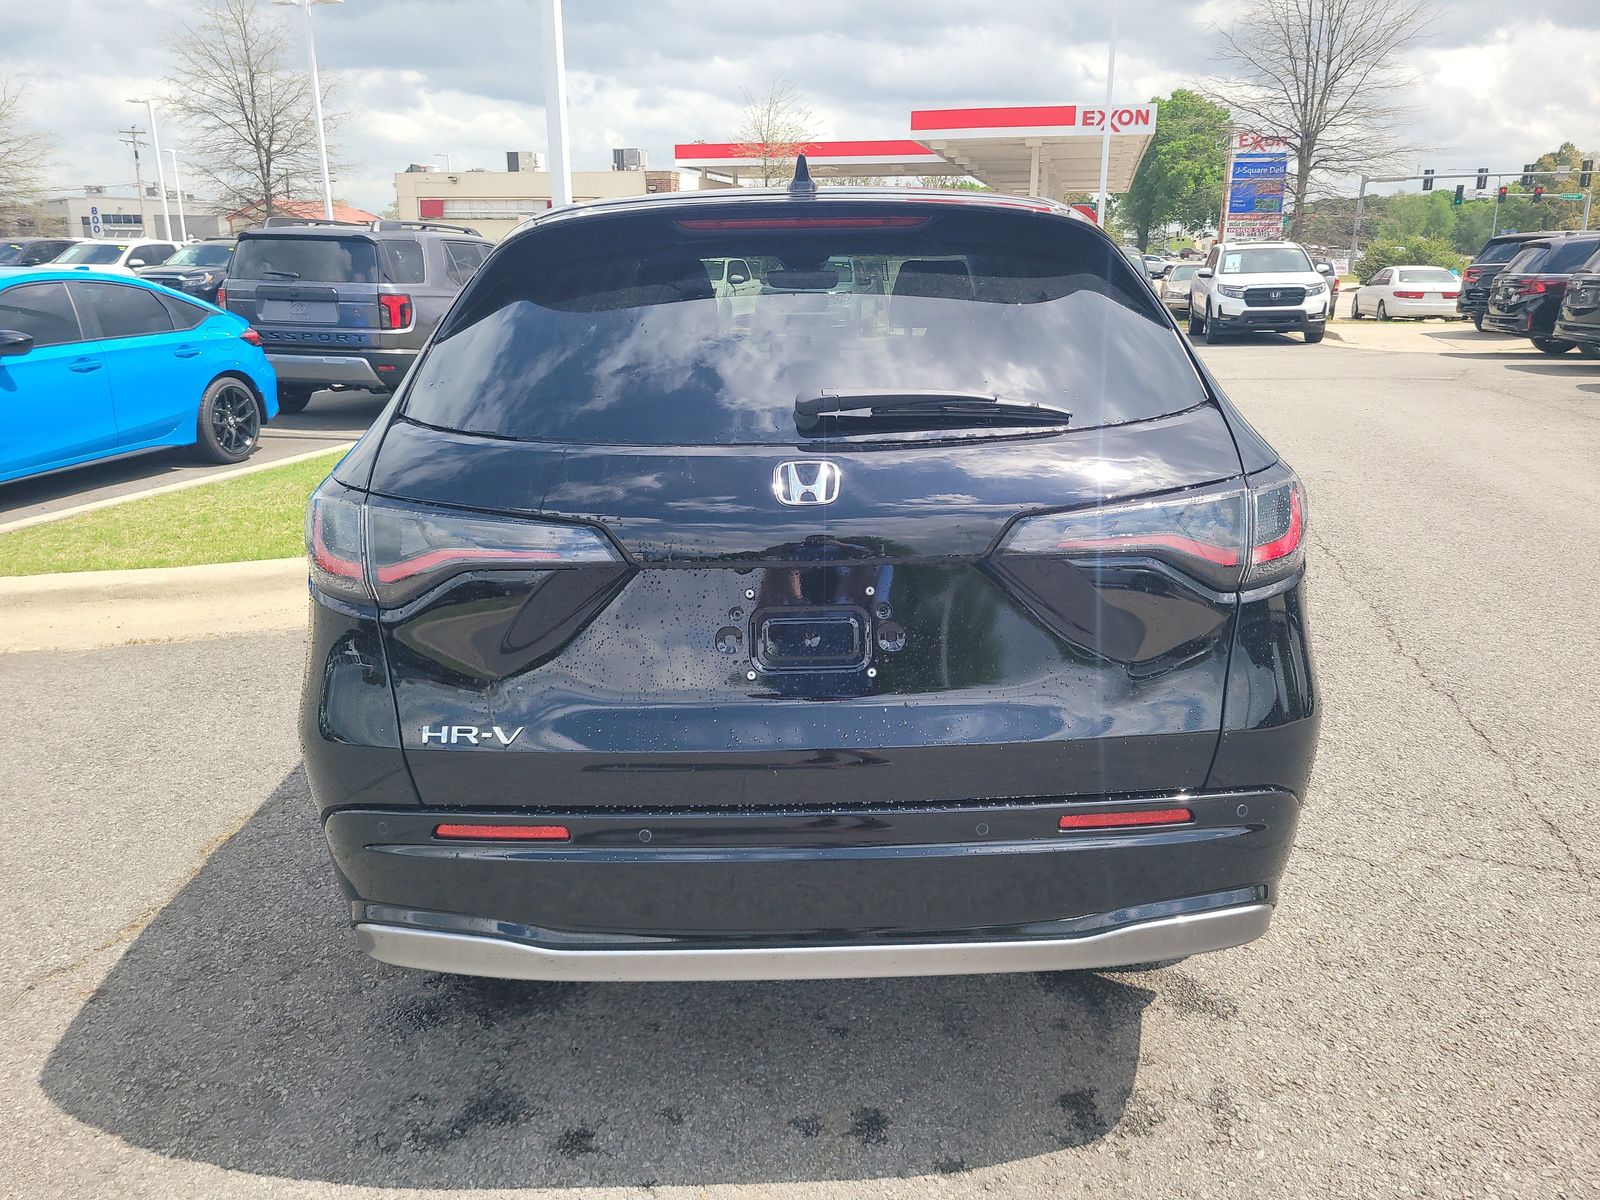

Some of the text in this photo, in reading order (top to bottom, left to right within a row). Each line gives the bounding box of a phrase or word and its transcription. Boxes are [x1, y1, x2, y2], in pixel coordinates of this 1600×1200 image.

[1082, 109, 1150, 132] EXXON
[1235, 165, 1285, 175] J-Square Deli
[261, 331, 368, 344] SSPORT
[421, 725, 524, 745] HR-V
